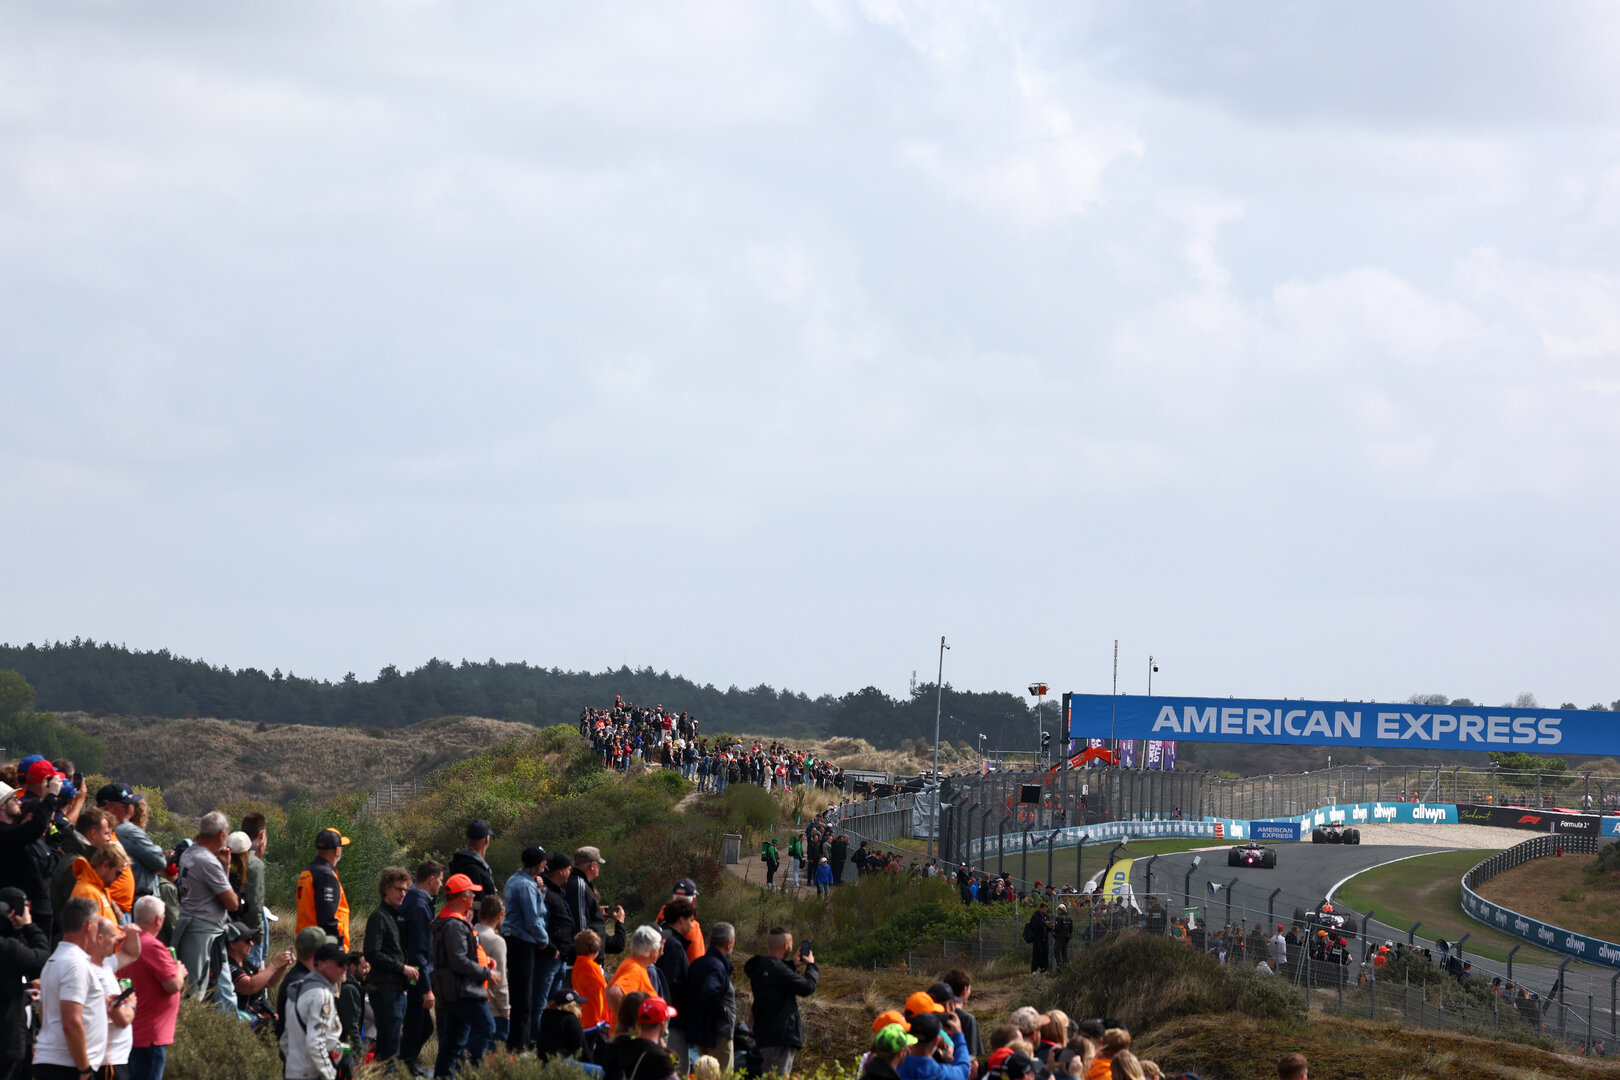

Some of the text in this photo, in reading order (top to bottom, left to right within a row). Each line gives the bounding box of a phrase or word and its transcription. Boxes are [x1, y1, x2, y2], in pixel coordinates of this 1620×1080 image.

[1152, 705, 1562, 745] AMERICAN EXPRESS
[1413, 804, 1446, 824] allwyn
[1560, 820, 1583, 829] Formula
[1566, 934, 1585, 955] allwyn
